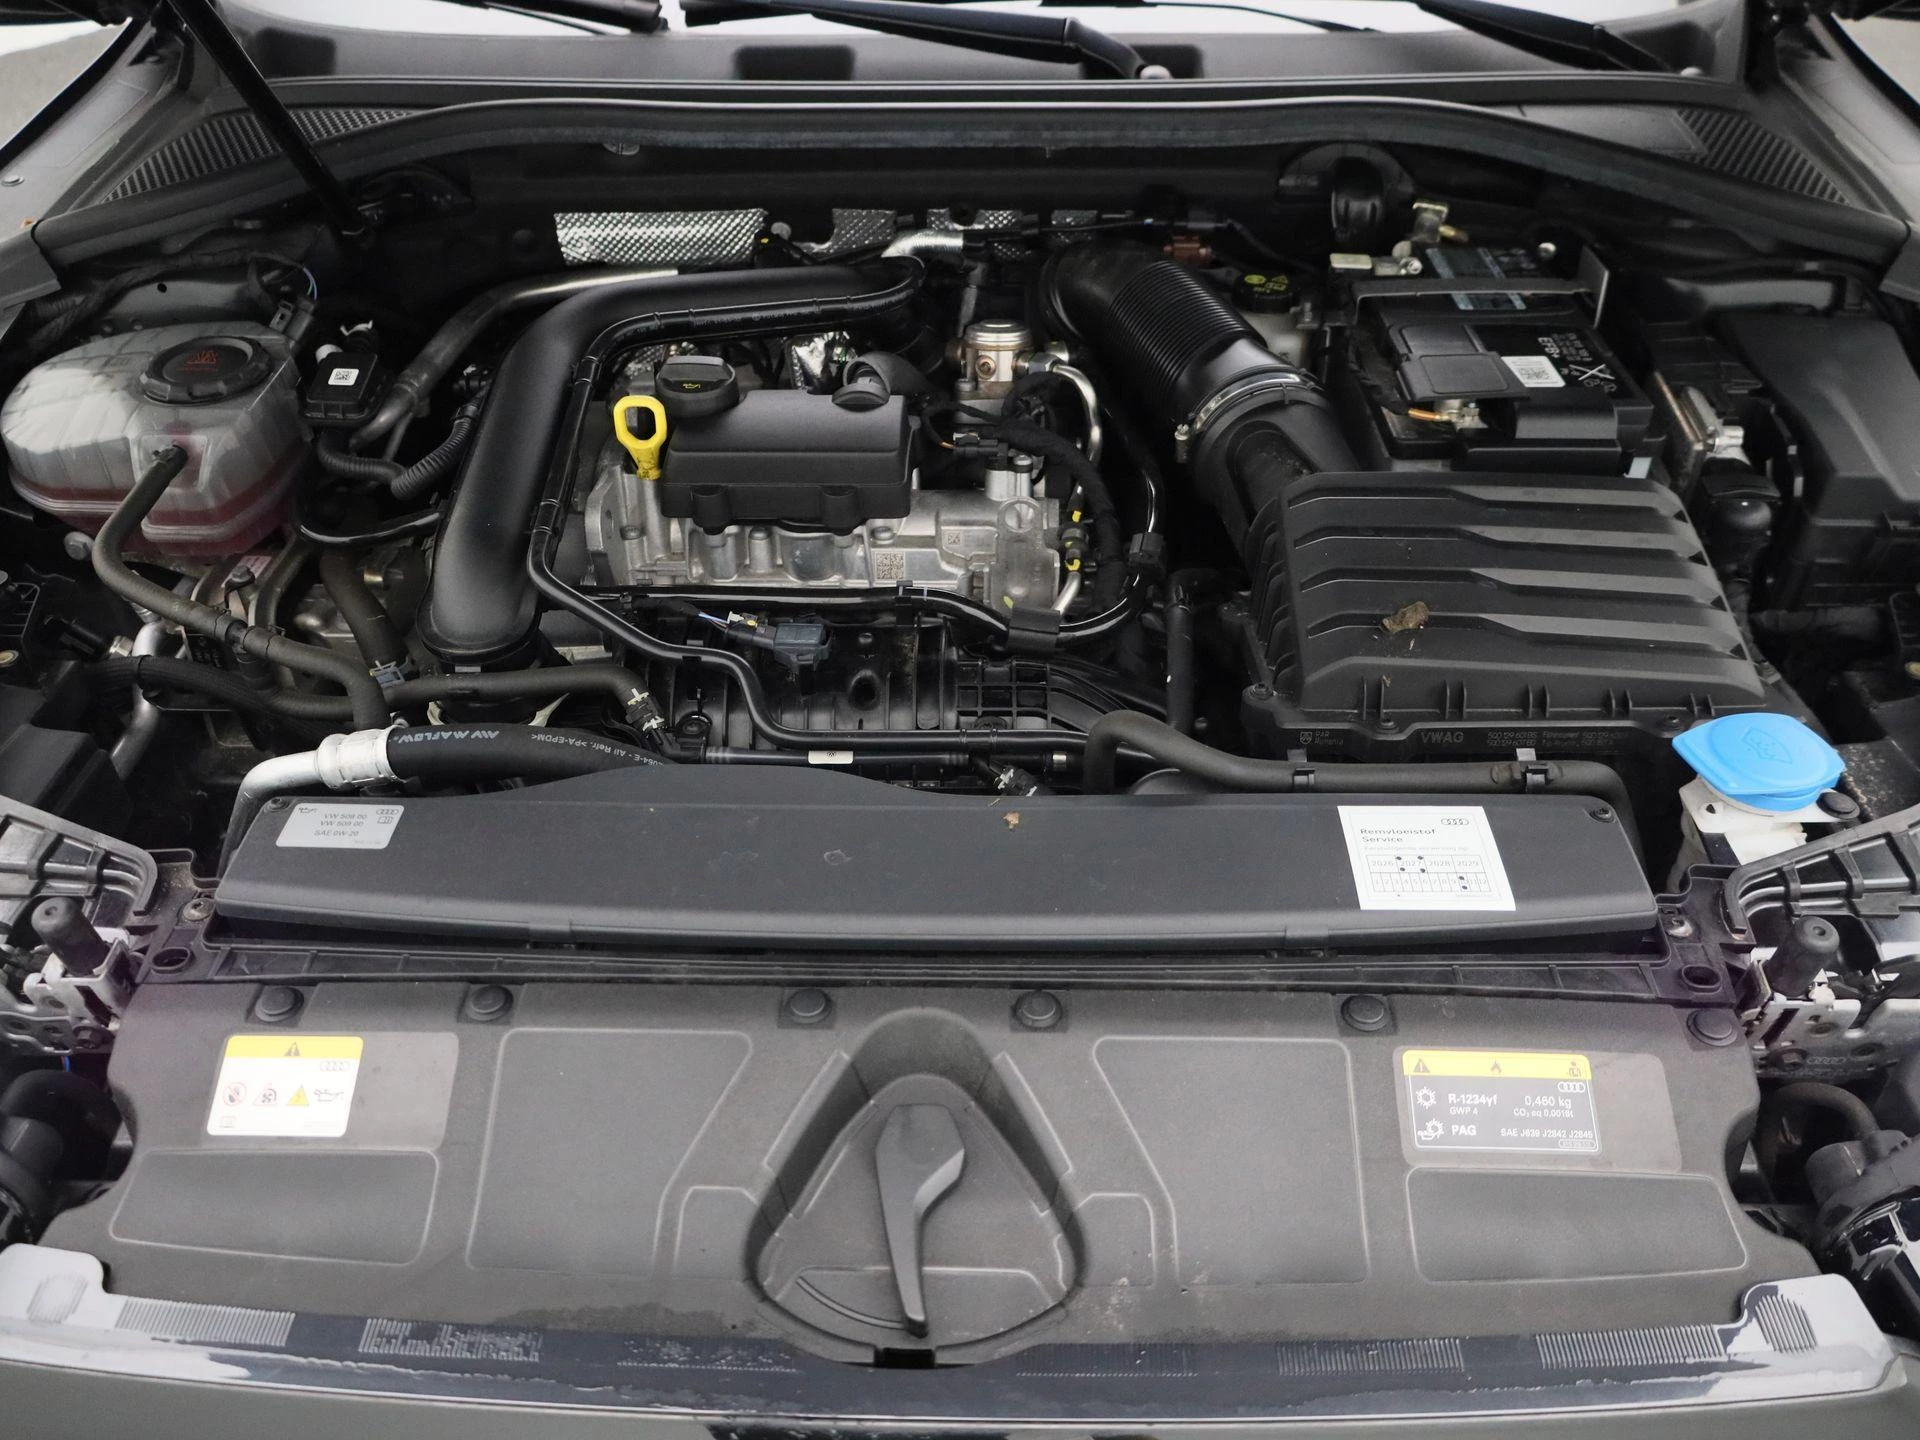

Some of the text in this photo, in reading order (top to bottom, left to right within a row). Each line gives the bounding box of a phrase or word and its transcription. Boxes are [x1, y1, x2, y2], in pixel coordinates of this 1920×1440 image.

[398, 730, 471, 744] MAFLOW
[1420, 731, 1464, 743] VWAG
[1448, 1093, 1498, 1107] R-1234yf
[1558, 1096, 1571, 1109] kg
[1450, 1107, 1471, 1115] GWP
[1452, 1125, 1477, 1136] PAG
[1500, 1129, 1518, 1137] SAE
